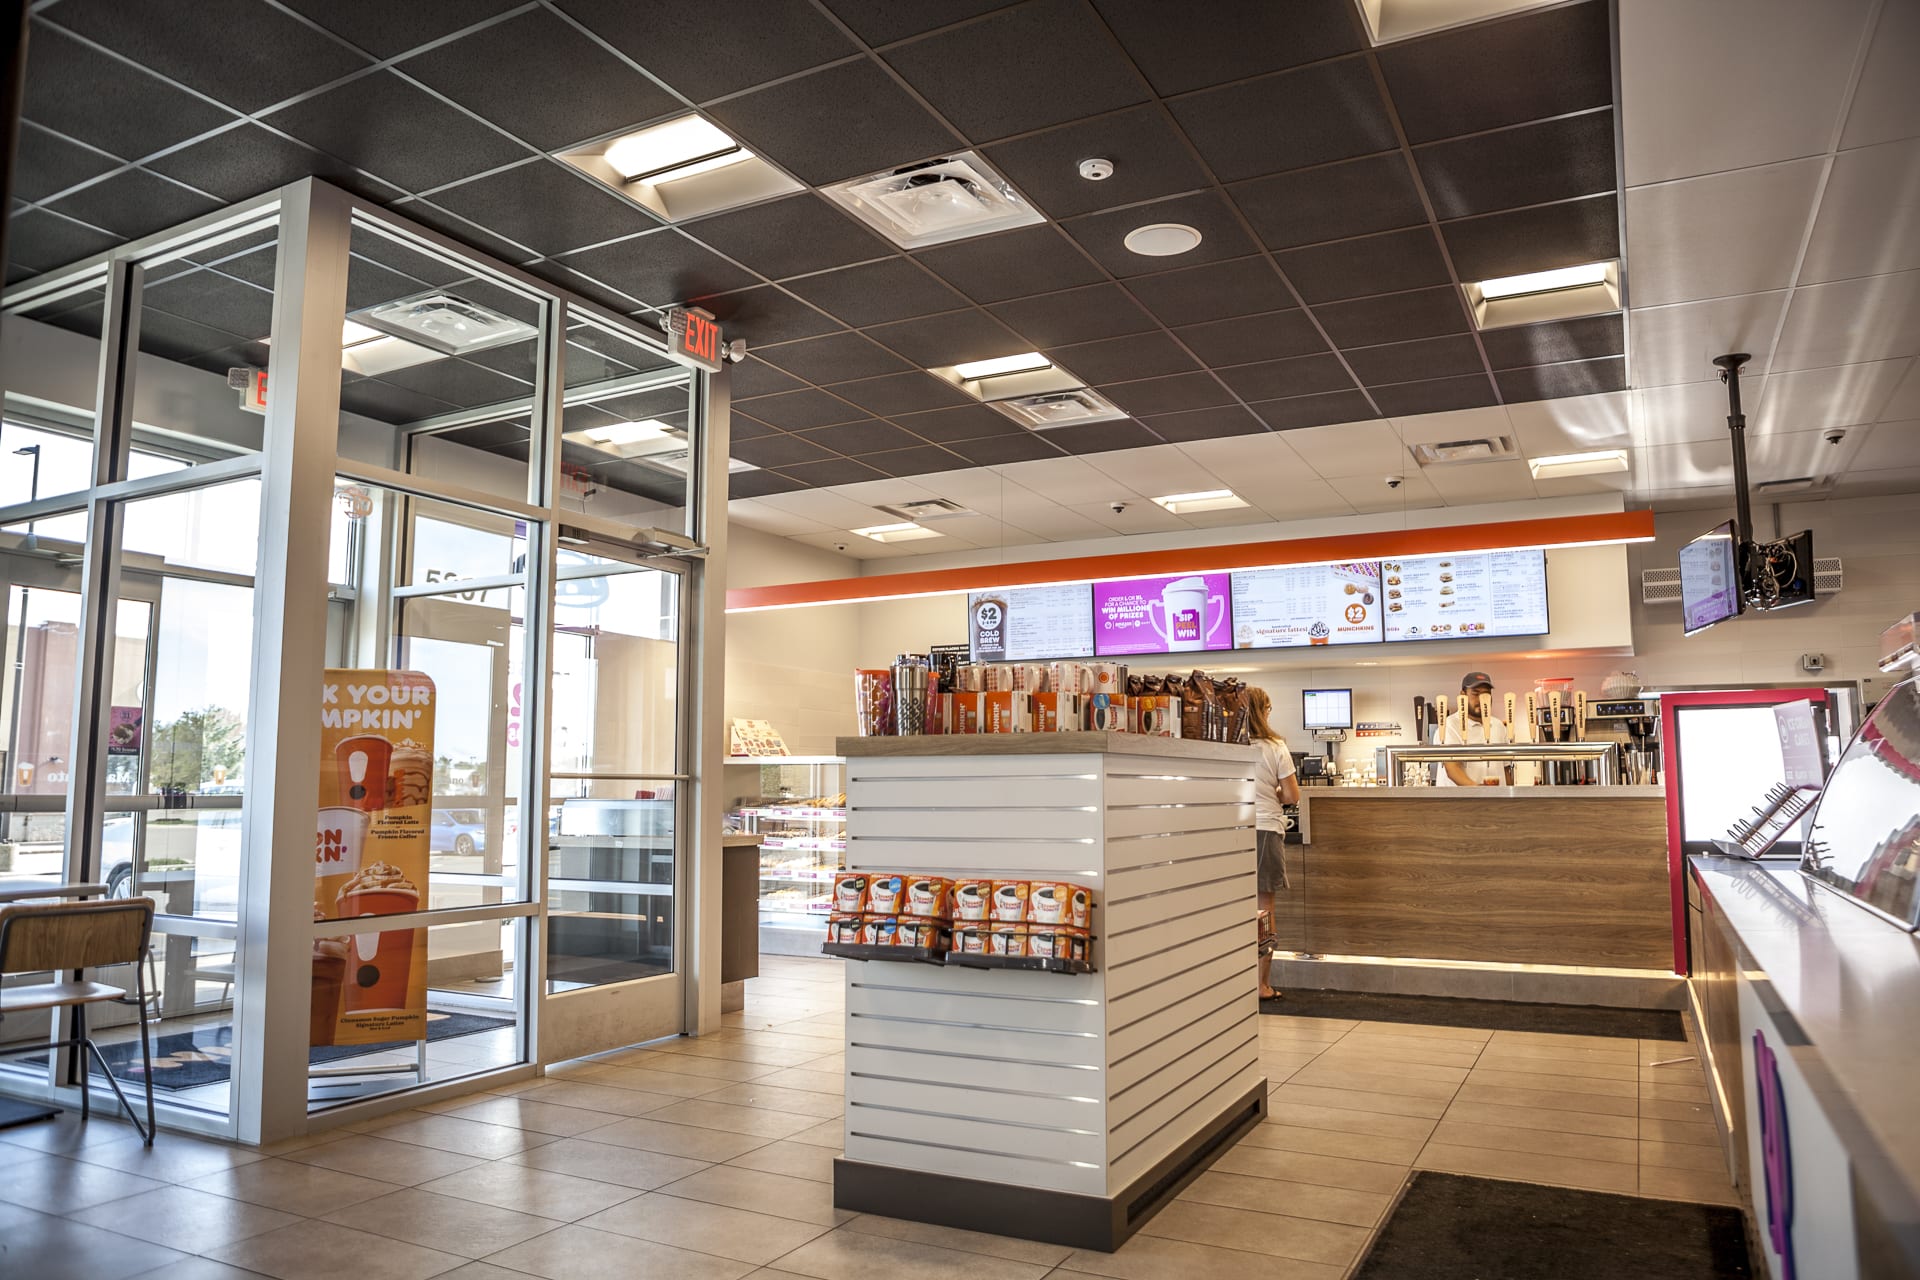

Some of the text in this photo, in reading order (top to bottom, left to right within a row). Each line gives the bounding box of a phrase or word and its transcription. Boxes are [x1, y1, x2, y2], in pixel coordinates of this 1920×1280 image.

[685, 312, 718, 362] EXIT
[981, 607, 997, 620] $2
[1179, 613, 1194, 622] SIP
[1347, 606, 1364, 621] $2
[1177, 629, 1197, 638] WIN
[347, 684, 430, 705] YOUR
